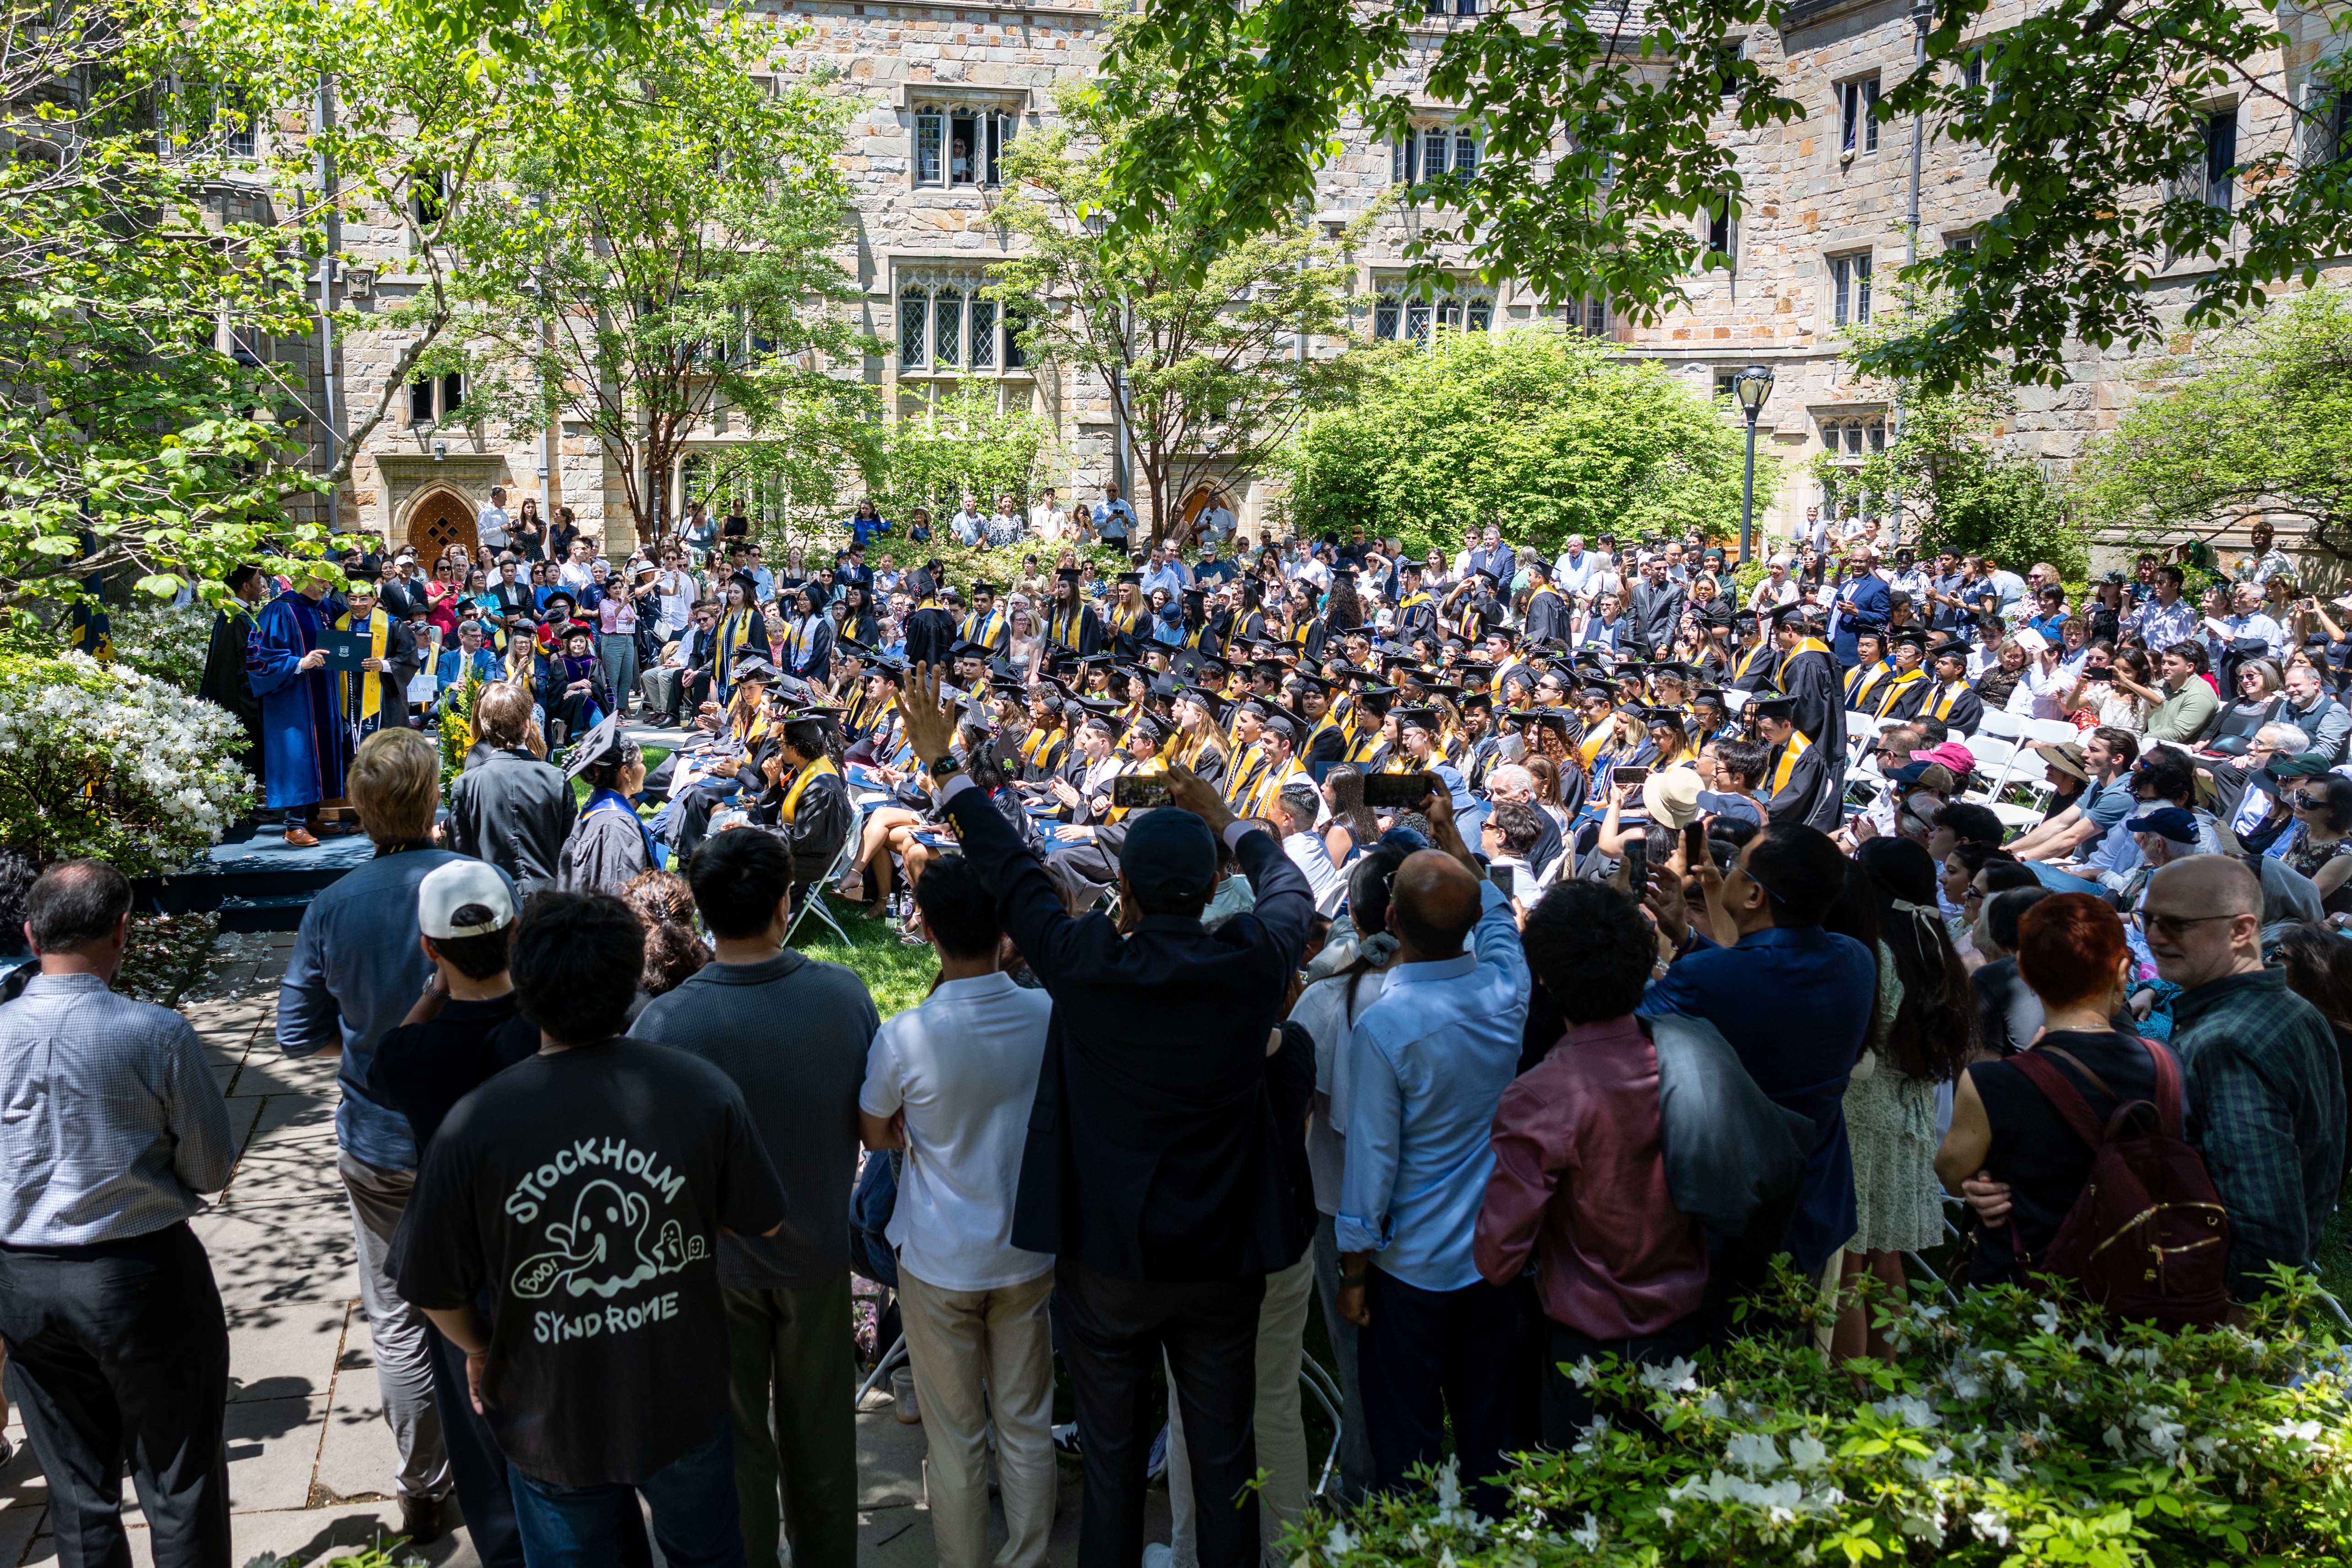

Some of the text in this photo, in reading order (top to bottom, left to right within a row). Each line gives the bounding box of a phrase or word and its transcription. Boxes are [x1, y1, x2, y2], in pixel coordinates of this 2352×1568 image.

[505, 1137, 685, 1223] STOCKHOLM
[519, 1259, 559, 1292] BOO!
[534, 1291, 679, 1344] SYNDROME
